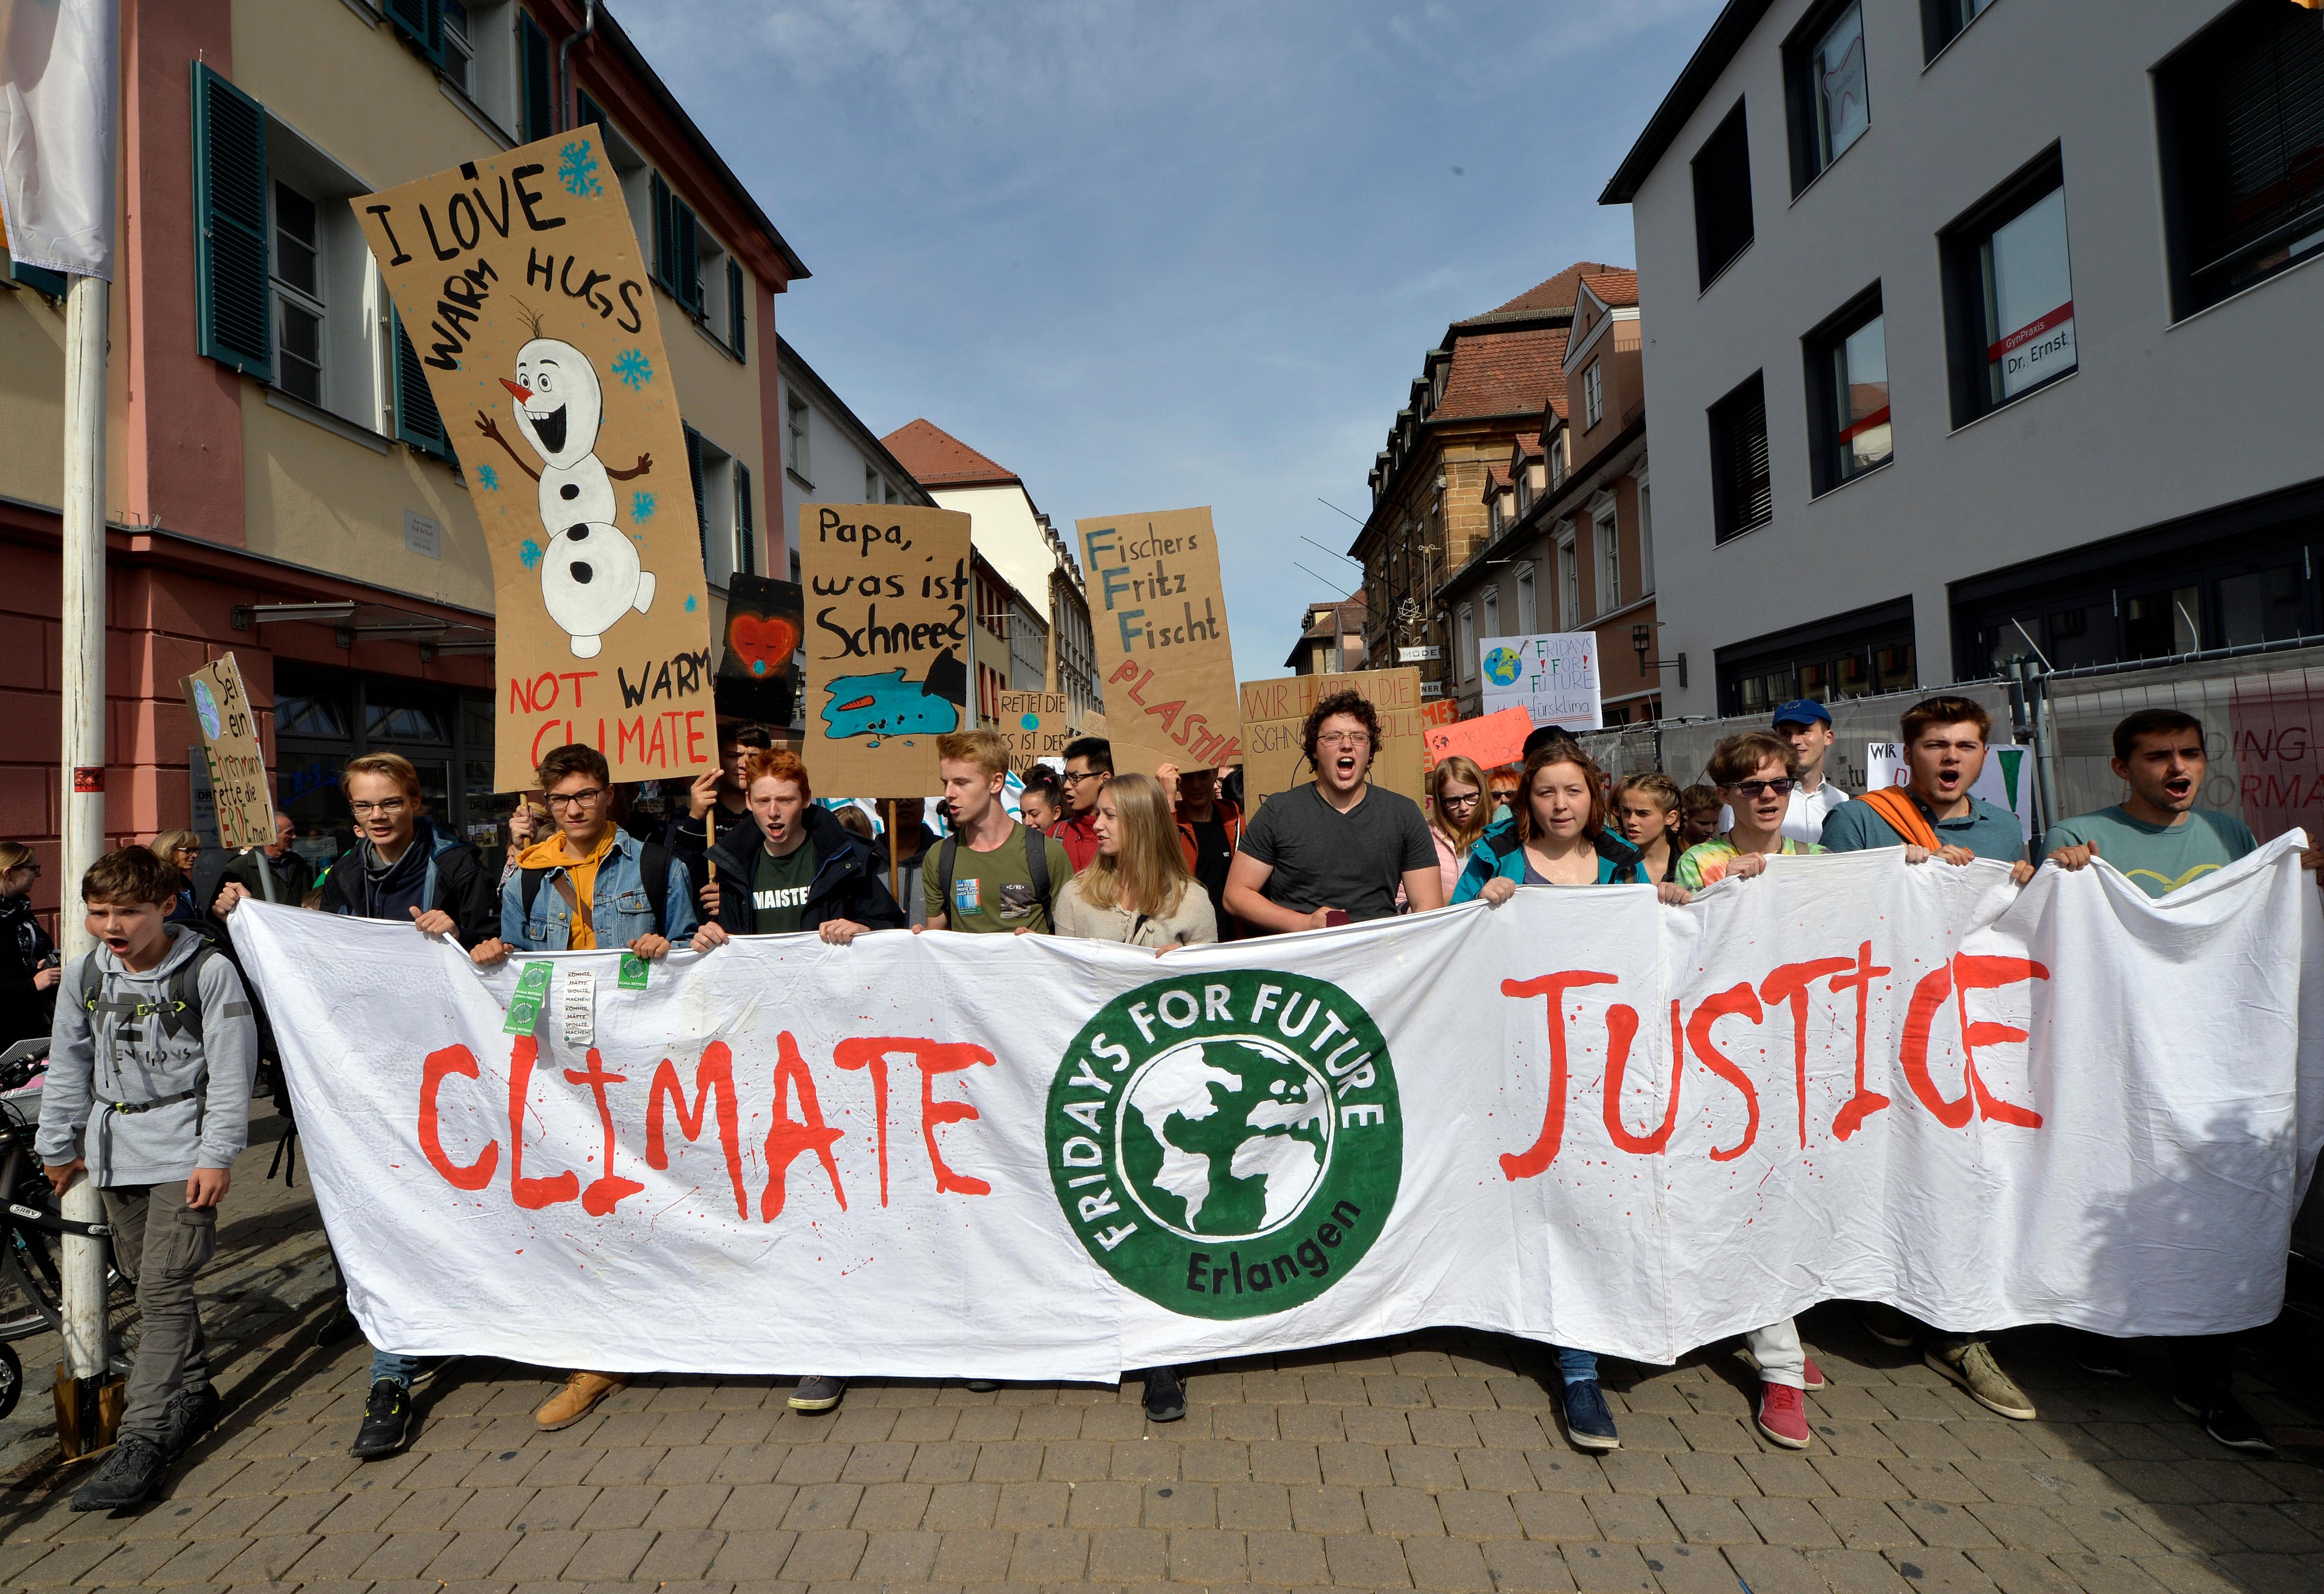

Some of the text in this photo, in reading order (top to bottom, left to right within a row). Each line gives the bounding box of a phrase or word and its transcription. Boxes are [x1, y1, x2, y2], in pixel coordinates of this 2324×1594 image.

[366, 164, 566, 266] I LOVE
[527, 247, 642, 334] HUGS
[424, 258, 498, 371] WARM
[2006, 321, 2045, 348] GynPraxis
[2008, 331, 2067, 374] Dr. Ernst
[819, 508, 912, 557] Papa,
[1085, 522, 1197, 572] Fischers
[812, 556, 969, 601] was ist
[1102, 560, 1187, 610] Fritz
[816, 603, 966, 660] Schnee?
[1118, 597, 1221, 653] Fischt
[1402, 649, 1437, 658] MODE
[1535, 638, 1593, 658] FRIDAYS
[212, 662, 238, 706] Sei
[510, 671, 598, 714] NOT
[617, 647, 713, 709] WARM
[1245, 685, 1289, 719] WIR
[1379, 678, 1411, 705] DIE
[1530, 670, 1594, 693] FUTURE
[229, 705, 249, 738] ein
[1002, 693, 1065, 713] RETTET DIE
[1109, 659, 1243, 767] PLASTIK
[1021, 732, 1038, 750] IST
[1044, 734, 1066, 751] DER
[1871, 743, 1897, 760] WIR
[212, 781, 257, 809] rette die
[220, 803, 252, 847] ERDE
[753, 885, 810, 910] MAISTE
[1499, 940, 2050, 1182] JUSTICE
[418, 1030, 997, 1223] CLIMATE
[1062, 983, 1384, 1252] FRIDAYS FOR FUTURE
[14, 1206, 38, 1216] ABUS
[1187, 1199, 1362, 1295] Erlangen
